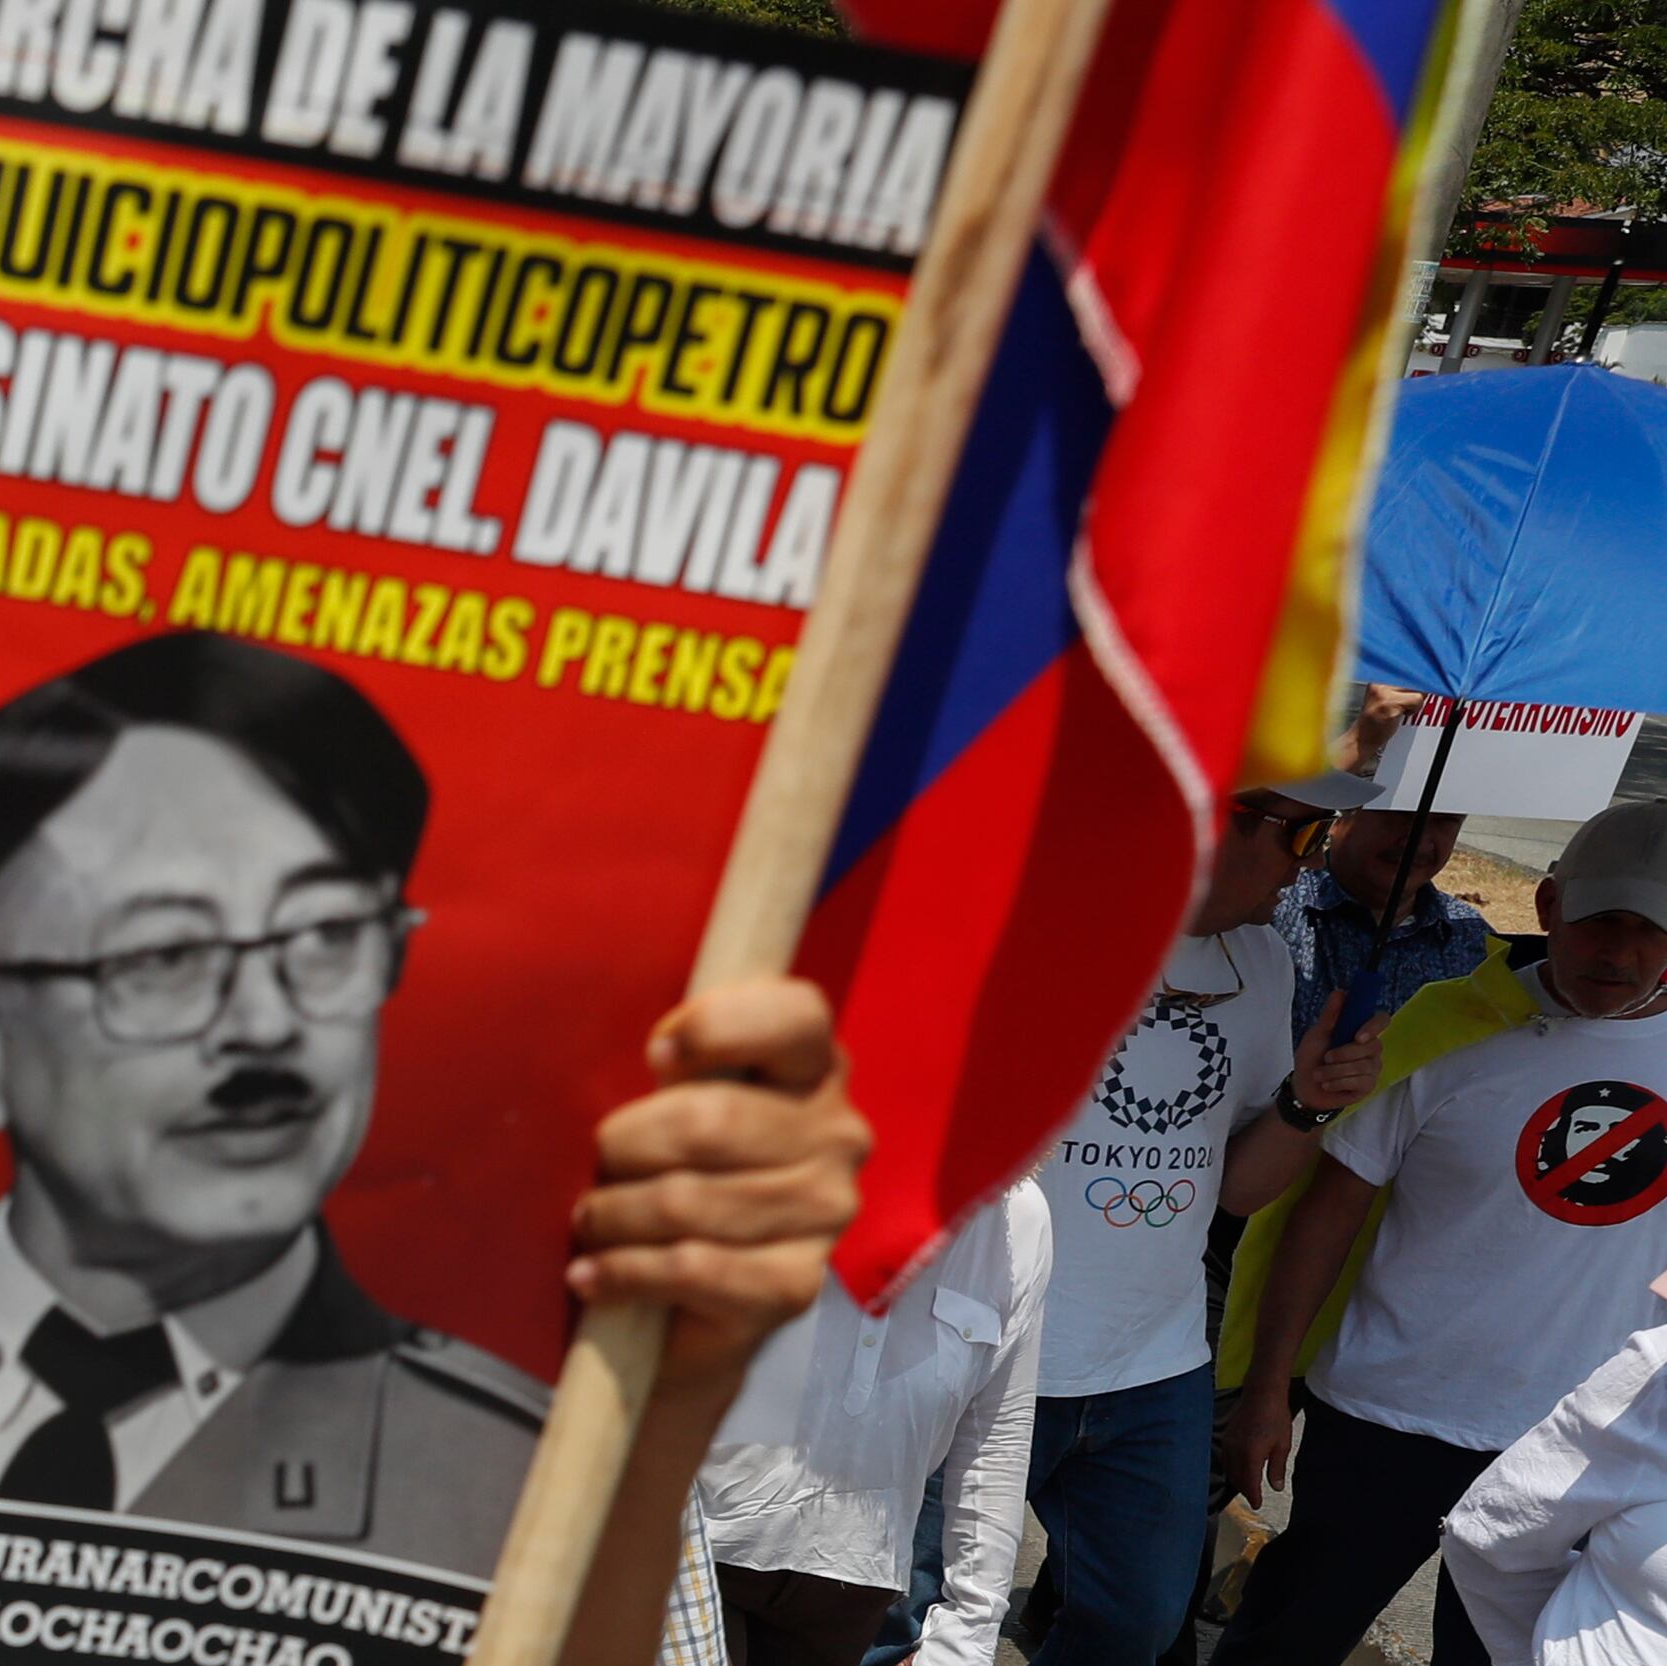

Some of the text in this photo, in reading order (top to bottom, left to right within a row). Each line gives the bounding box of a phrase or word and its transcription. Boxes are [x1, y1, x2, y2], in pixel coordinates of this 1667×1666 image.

[261, 0, 410, 158] DE
[397, 11, 535, 182] LA
[523, 32, 962, 257] MAYORIA
[270, 376, 502, 555] CNEL.
[511, 416, 843, 611] DAVILA
[167, 546, 534, 682] AMENAZAS
[535, 607, 797, 724] PRENSA
[1061, 1140, 1162, 1170] TOKYO
